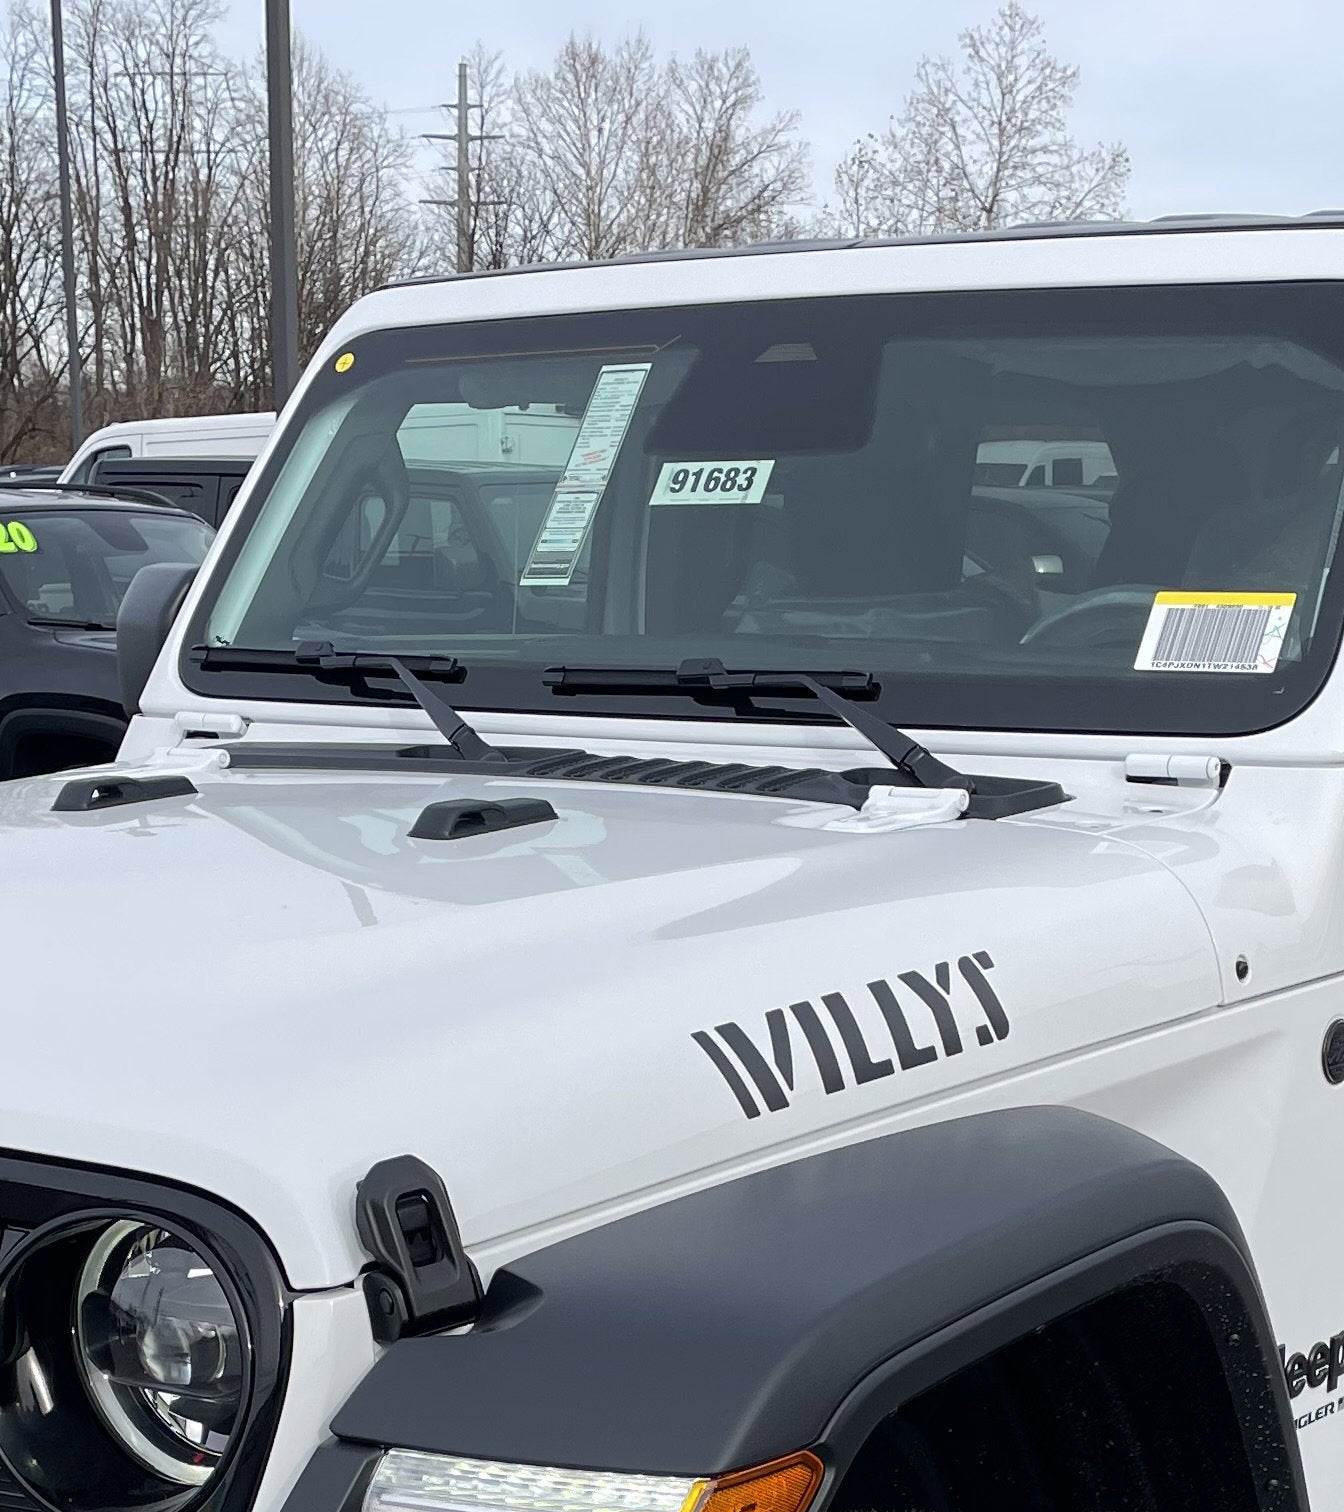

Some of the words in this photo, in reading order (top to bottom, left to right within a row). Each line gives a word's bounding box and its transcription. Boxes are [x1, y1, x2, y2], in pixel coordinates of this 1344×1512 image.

[669, 466, 757, 493] 91683
[690, 950, 1010, 1119] WILLYS
[1296, 1402, 1335, 1430] GLER
